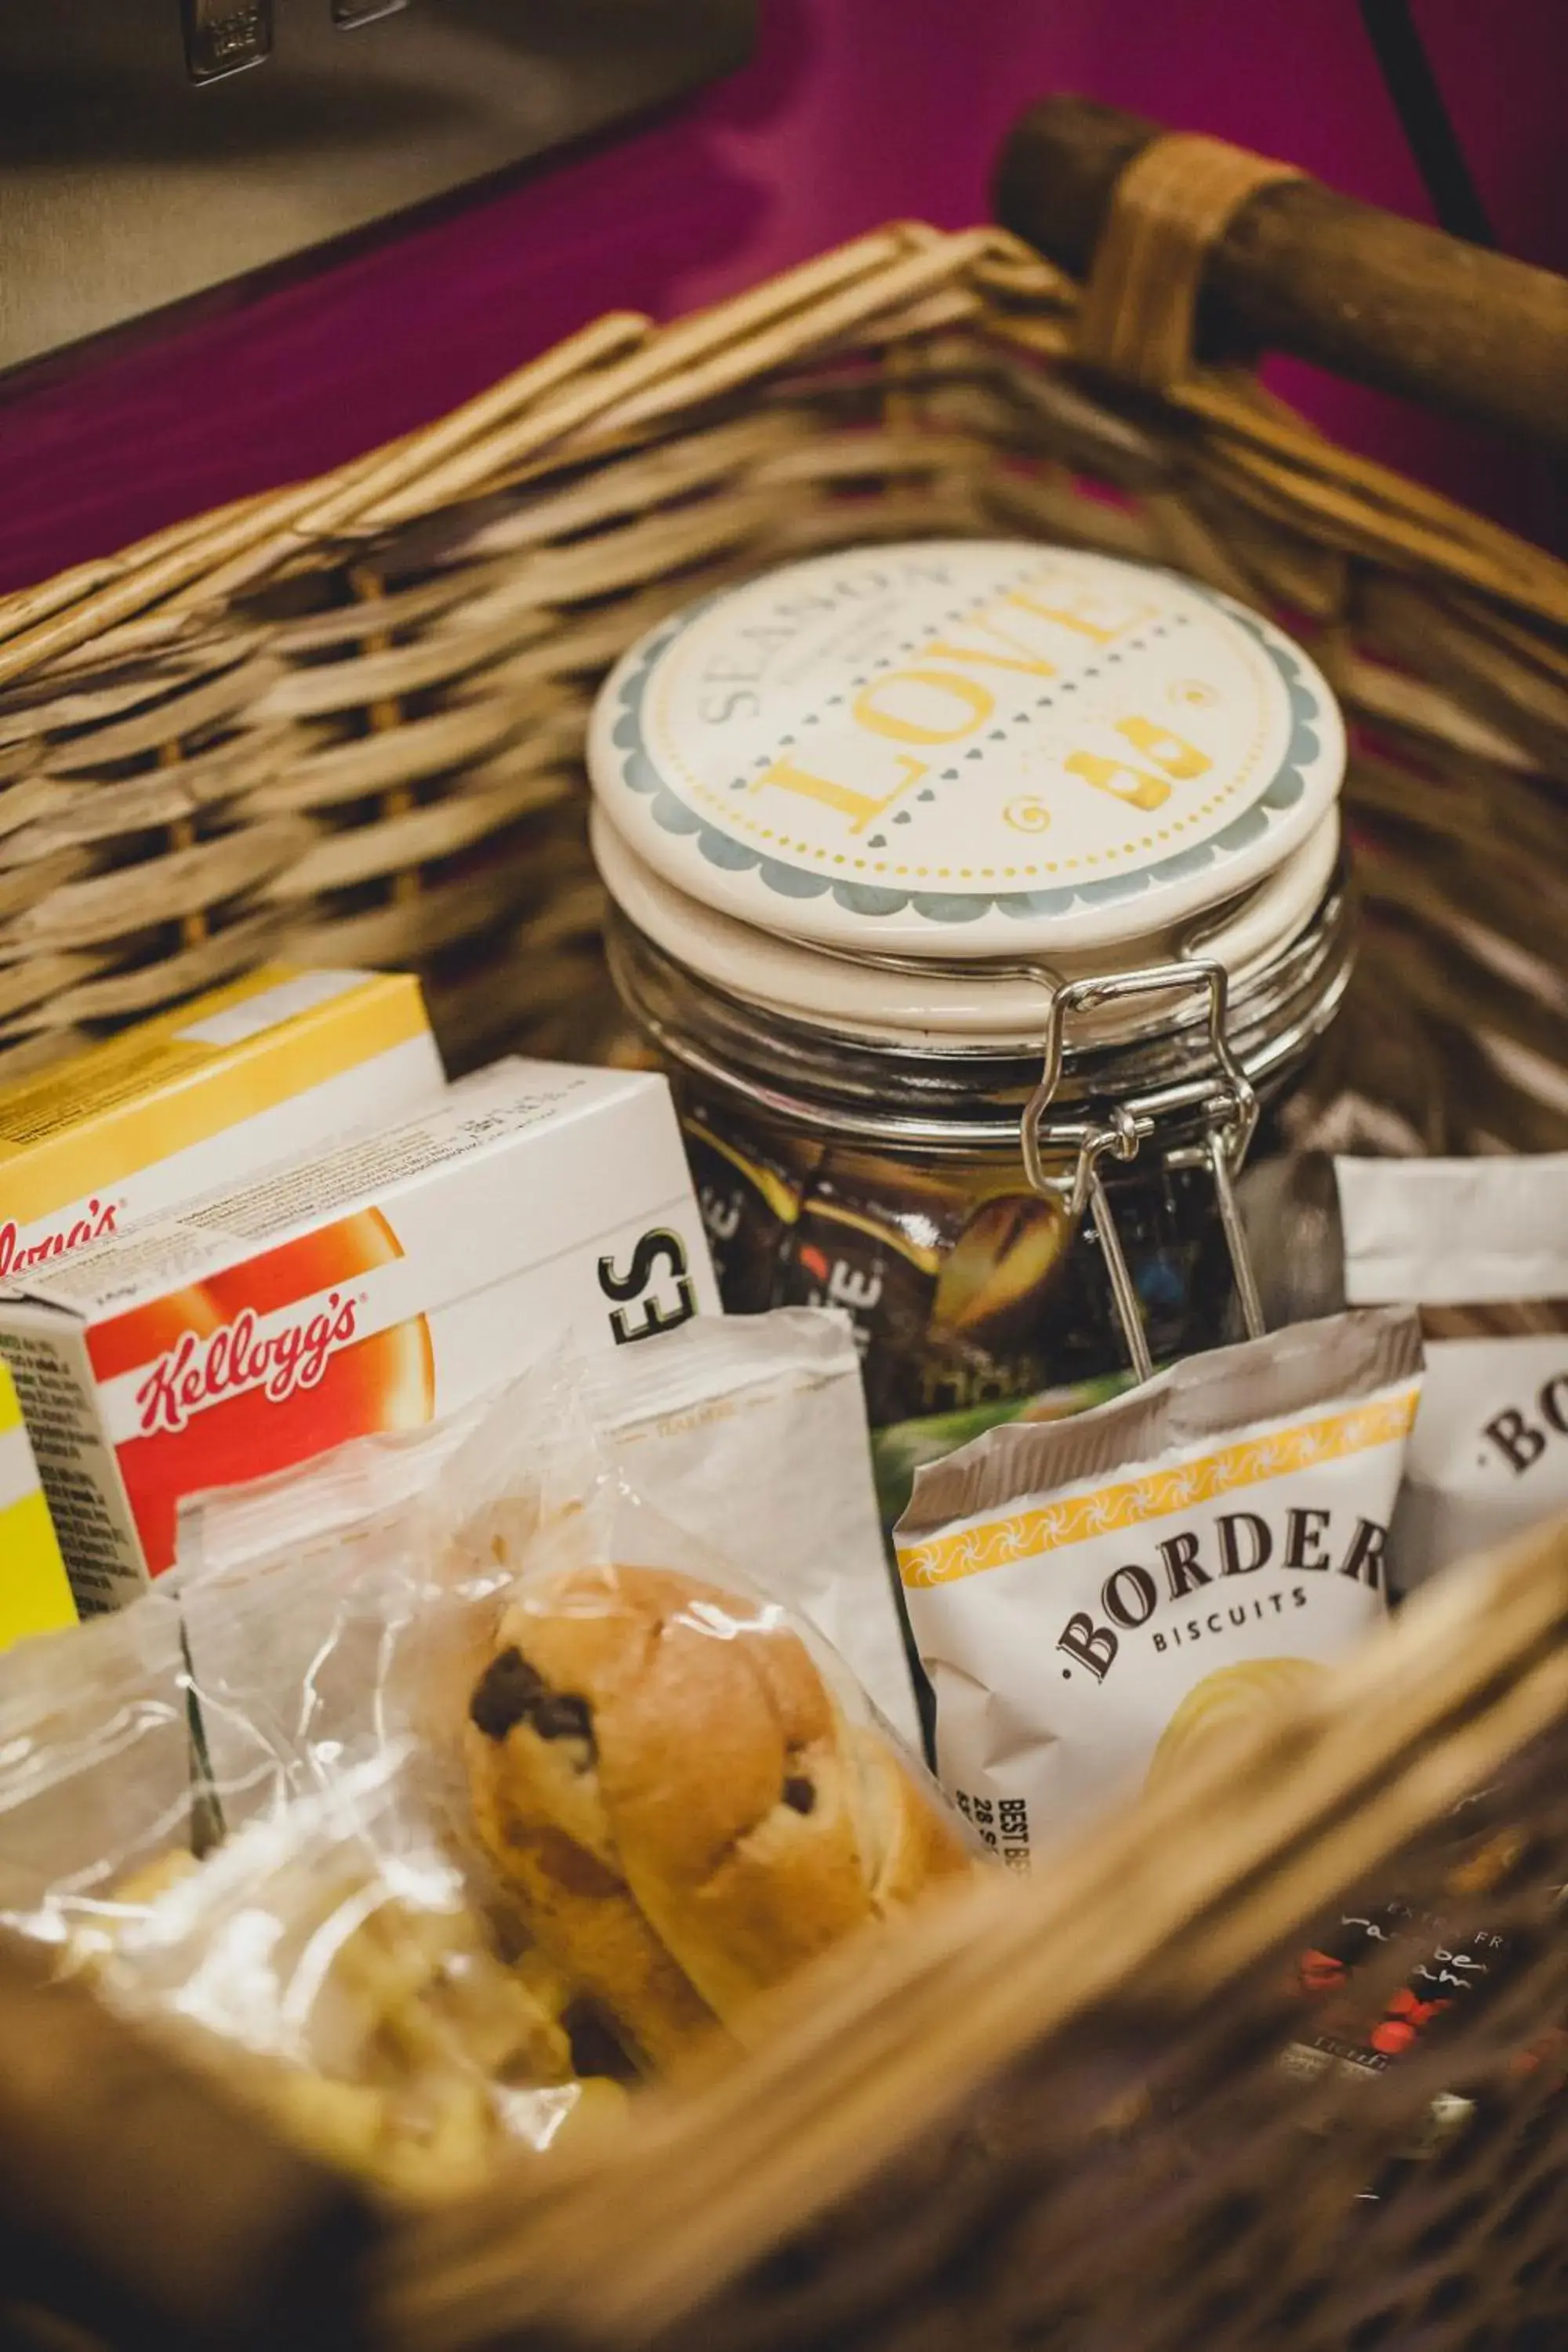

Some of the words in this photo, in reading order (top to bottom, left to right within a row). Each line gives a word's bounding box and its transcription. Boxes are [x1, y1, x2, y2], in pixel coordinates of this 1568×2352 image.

[747, 564, 1162, 836] LOVE
[135, 1293, 357, 1429] Kellogg's
[1054, 1507, 1388, 1685] BORDER
[1152, 1586, 1308, 1653] BISCUITS
[972, 1795, 993, 1825] 28
[998, 1798, 1029, 1843] BEST
